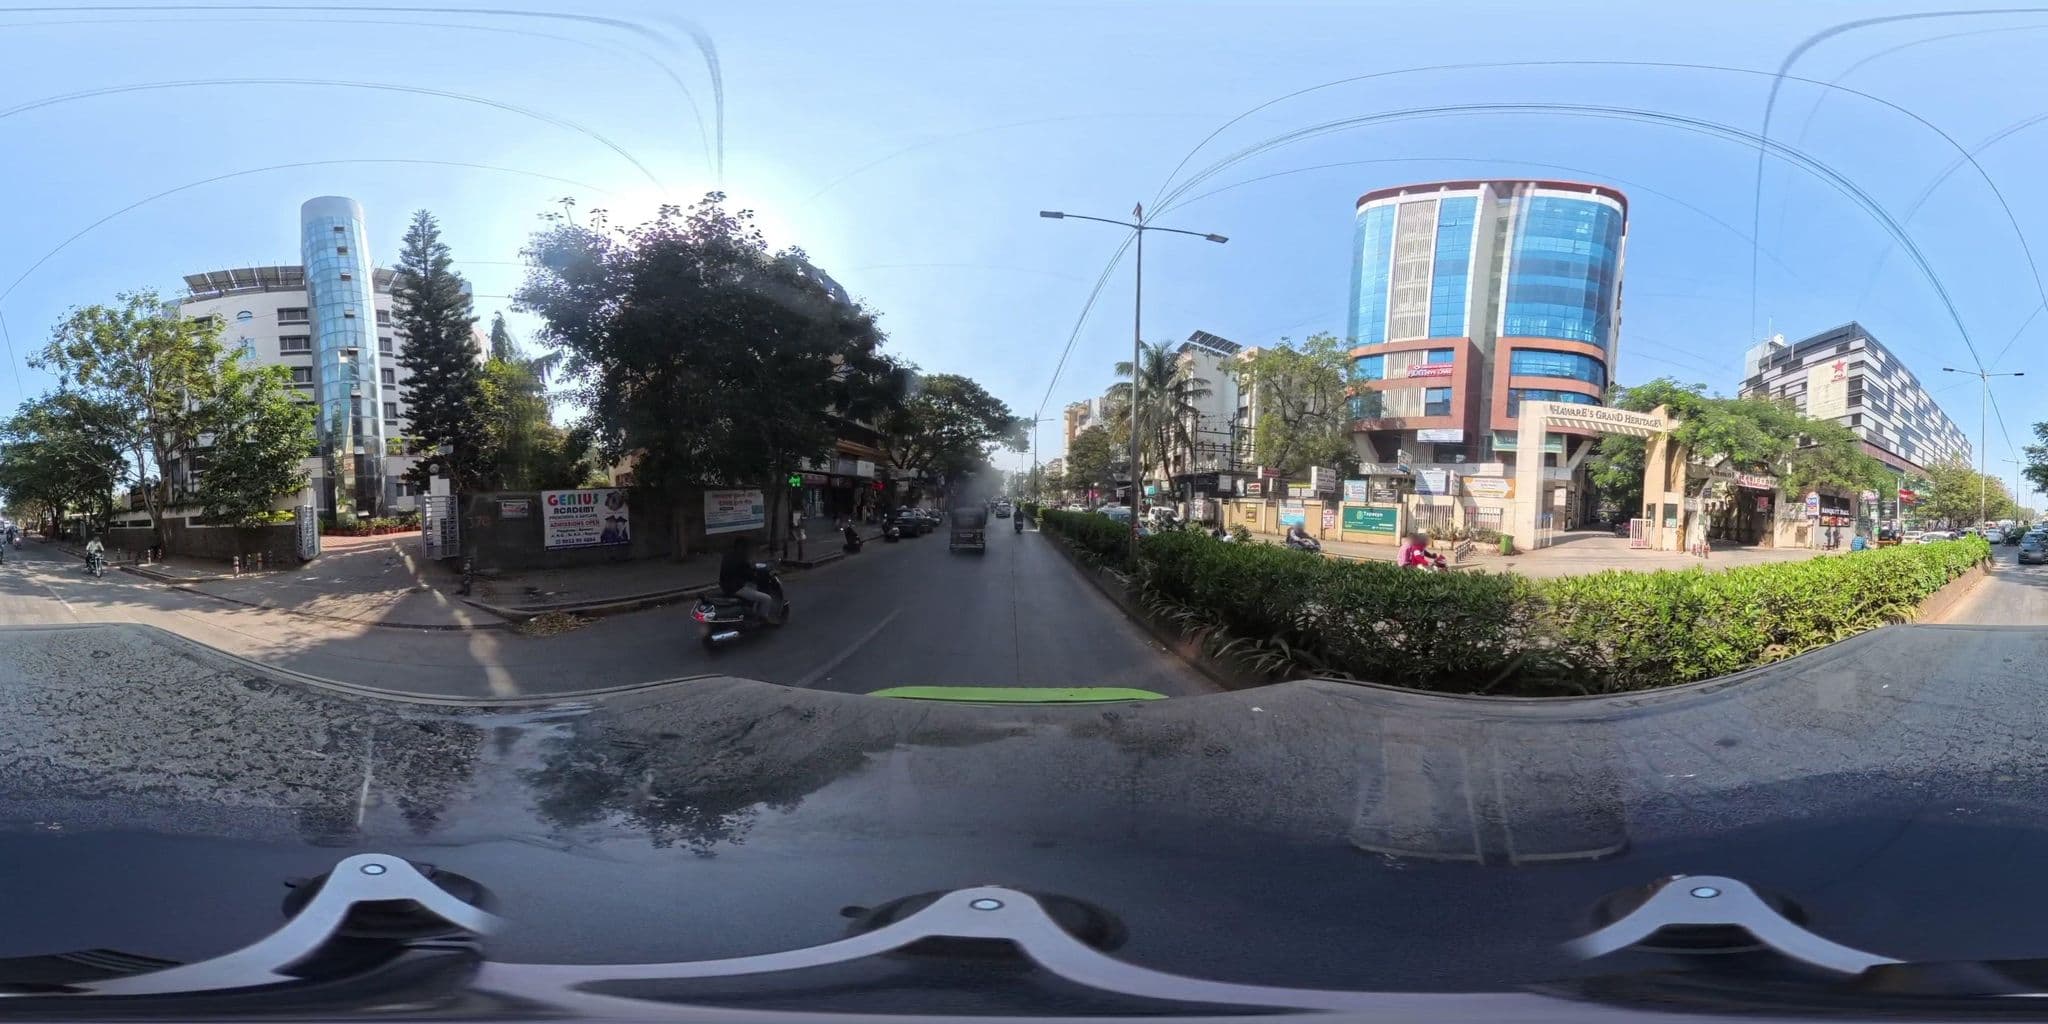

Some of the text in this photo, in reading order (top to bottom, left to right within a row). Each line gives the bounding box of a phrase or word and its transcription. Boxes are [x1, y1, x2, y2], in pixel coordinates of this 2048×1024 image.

[1551, 405, 1659, 428] HAWARE'S GRAND HERITAGE
[548, 493, 598, 506] GENIUS
[554, 506, 595, 514] ACADEMY
